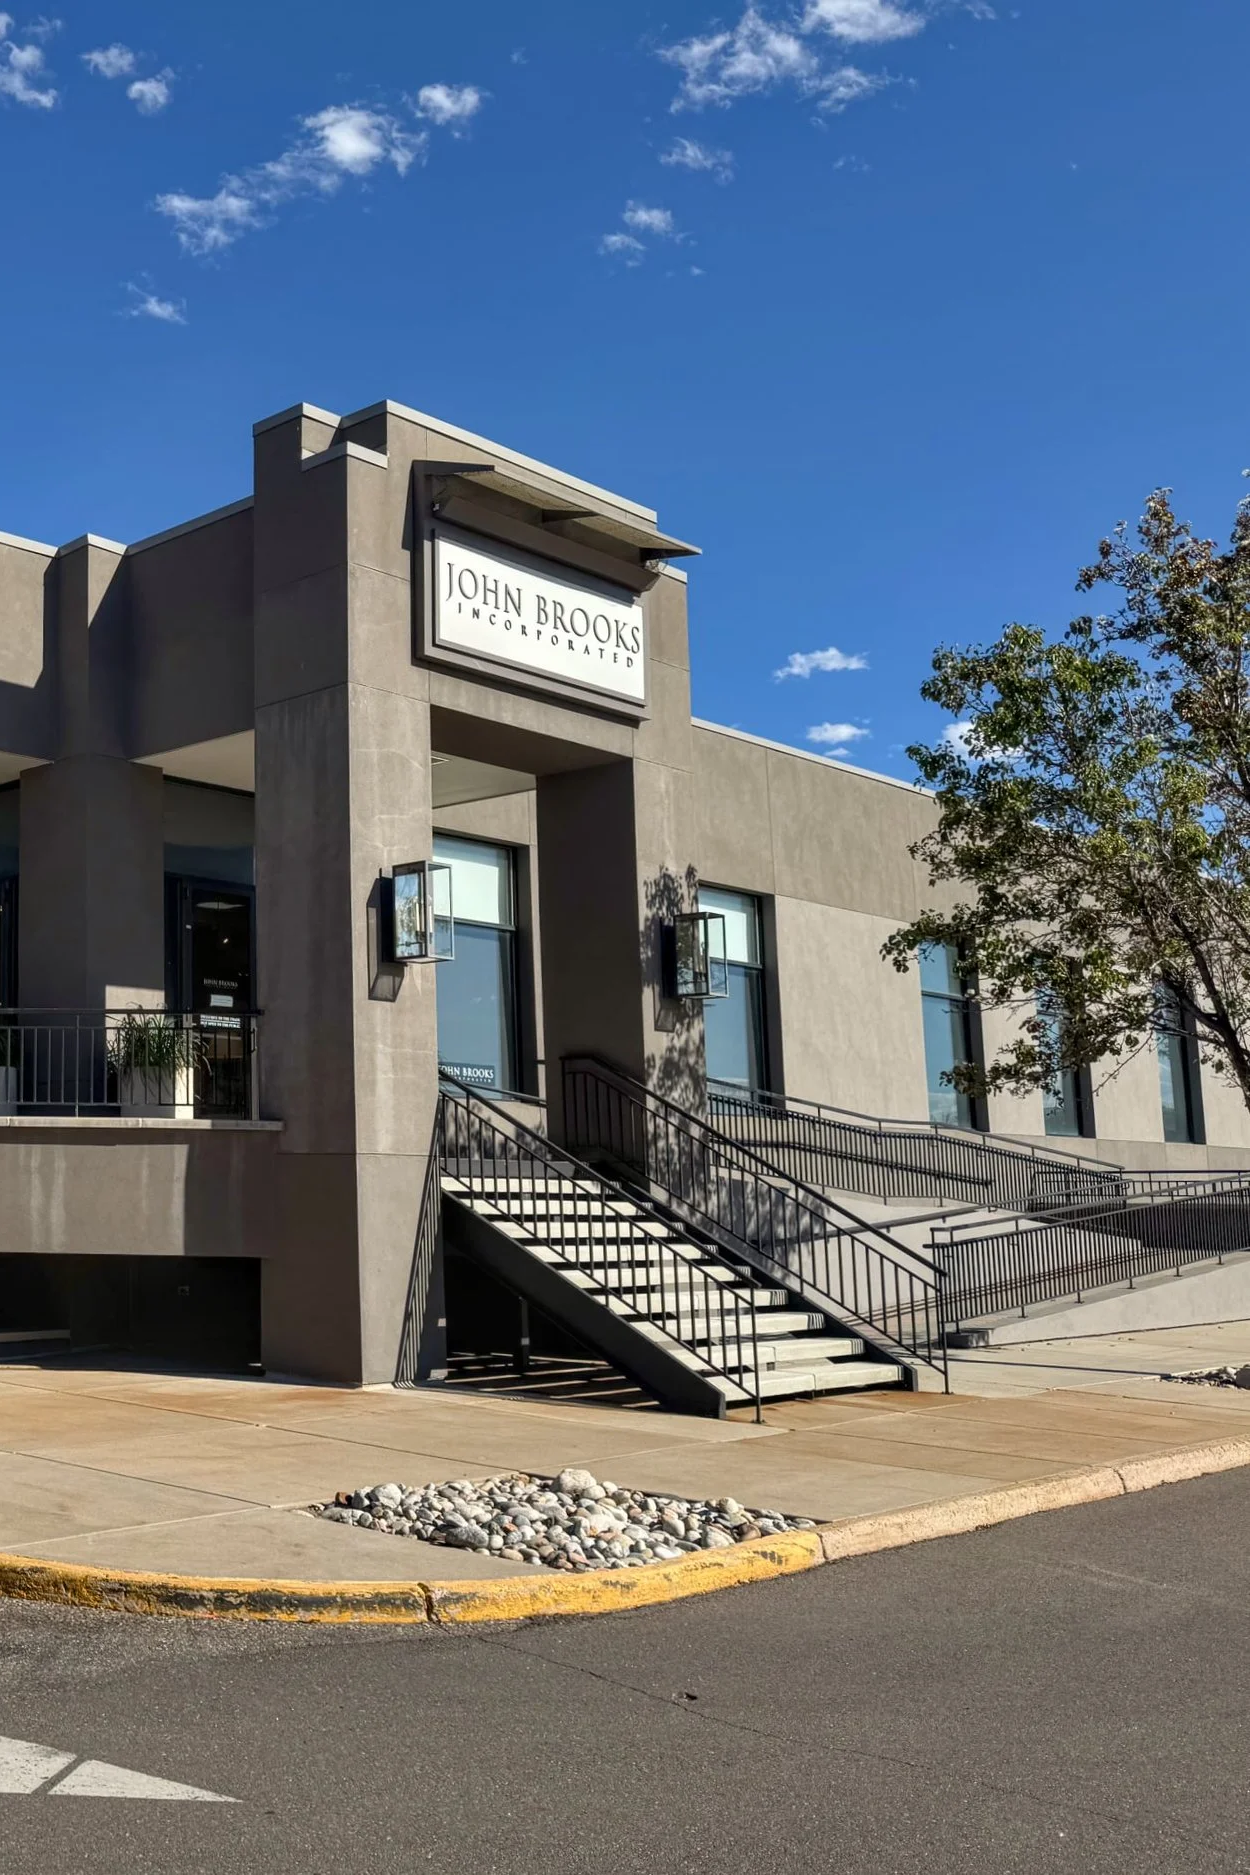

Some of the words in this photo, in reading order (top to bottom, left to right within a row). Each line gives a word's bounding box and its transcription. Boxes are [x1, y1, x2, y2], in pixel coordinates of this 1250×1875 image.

[446, 562, 522, 617] JOHN
[536, 594, 640, 654] BROOKS
[458, 602, 633, 668] INCORPORATED
[438, 1064, 460, 1076] OHN
[462, 1066, 494, 1079] BROOKS
